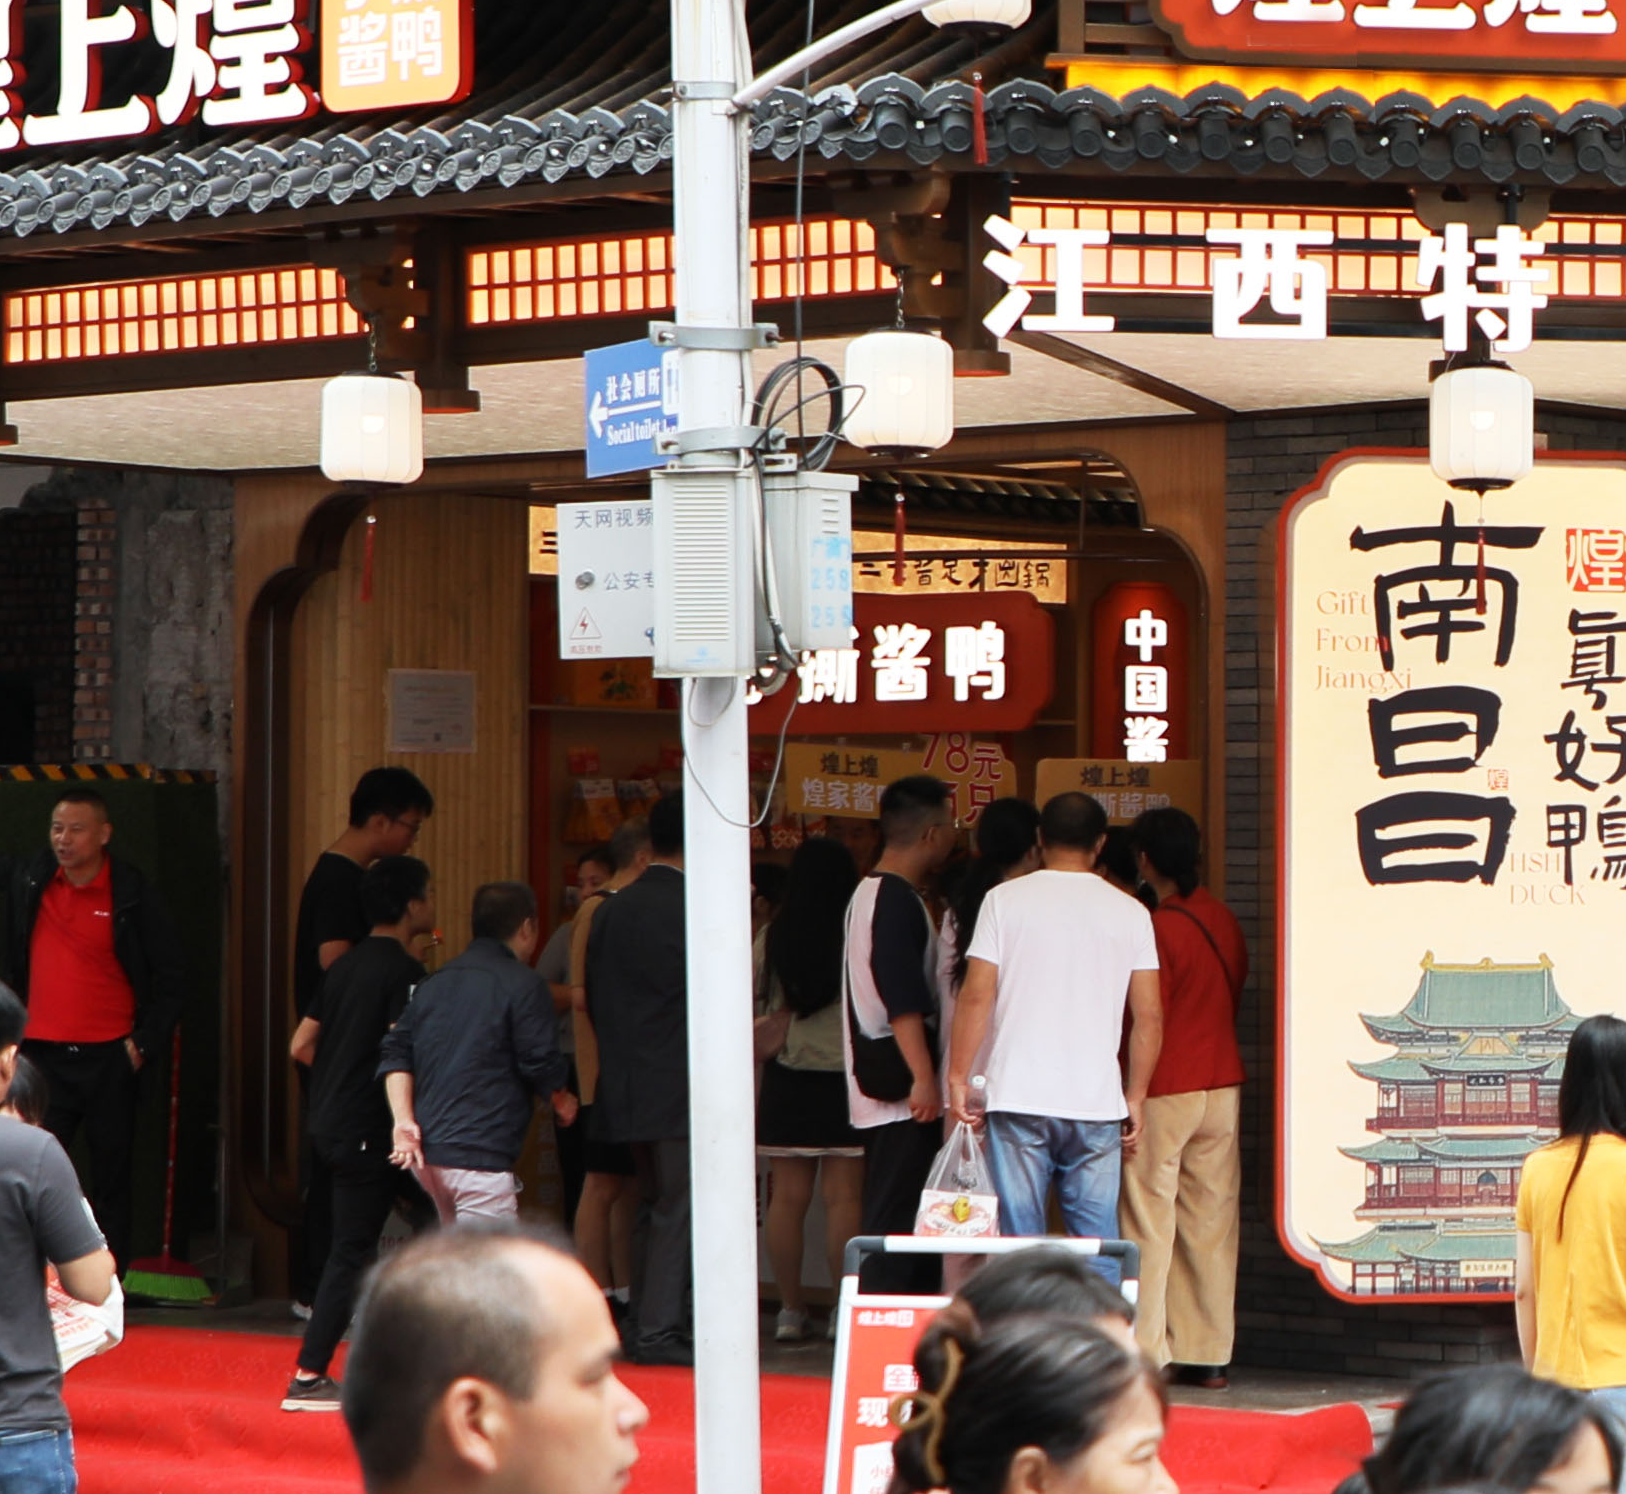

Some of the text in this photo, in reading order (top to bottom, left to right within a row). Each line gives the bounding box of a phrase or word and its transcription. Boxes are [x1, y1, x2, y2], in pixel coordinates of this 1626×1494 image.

[336, 4, 443, 88] 酱鸭
[605, 366, 661, 405] 社会厕所
[574, 507, 654, 529] 天网视频
[1315, 589, 1372, 616] Gift
[1315, 627, 1389, 653] From
[1315, 663, 1413, 695] Jiangxi
[1350, 499, 1547, 887] 南昌
[820, 751, 879, 780] 煌上煌
[921, 731, 1003, 782] 78元
[1079, 765, 1152, 789] 煌上煌
[1509, 884, 1586, 907] DUCK
